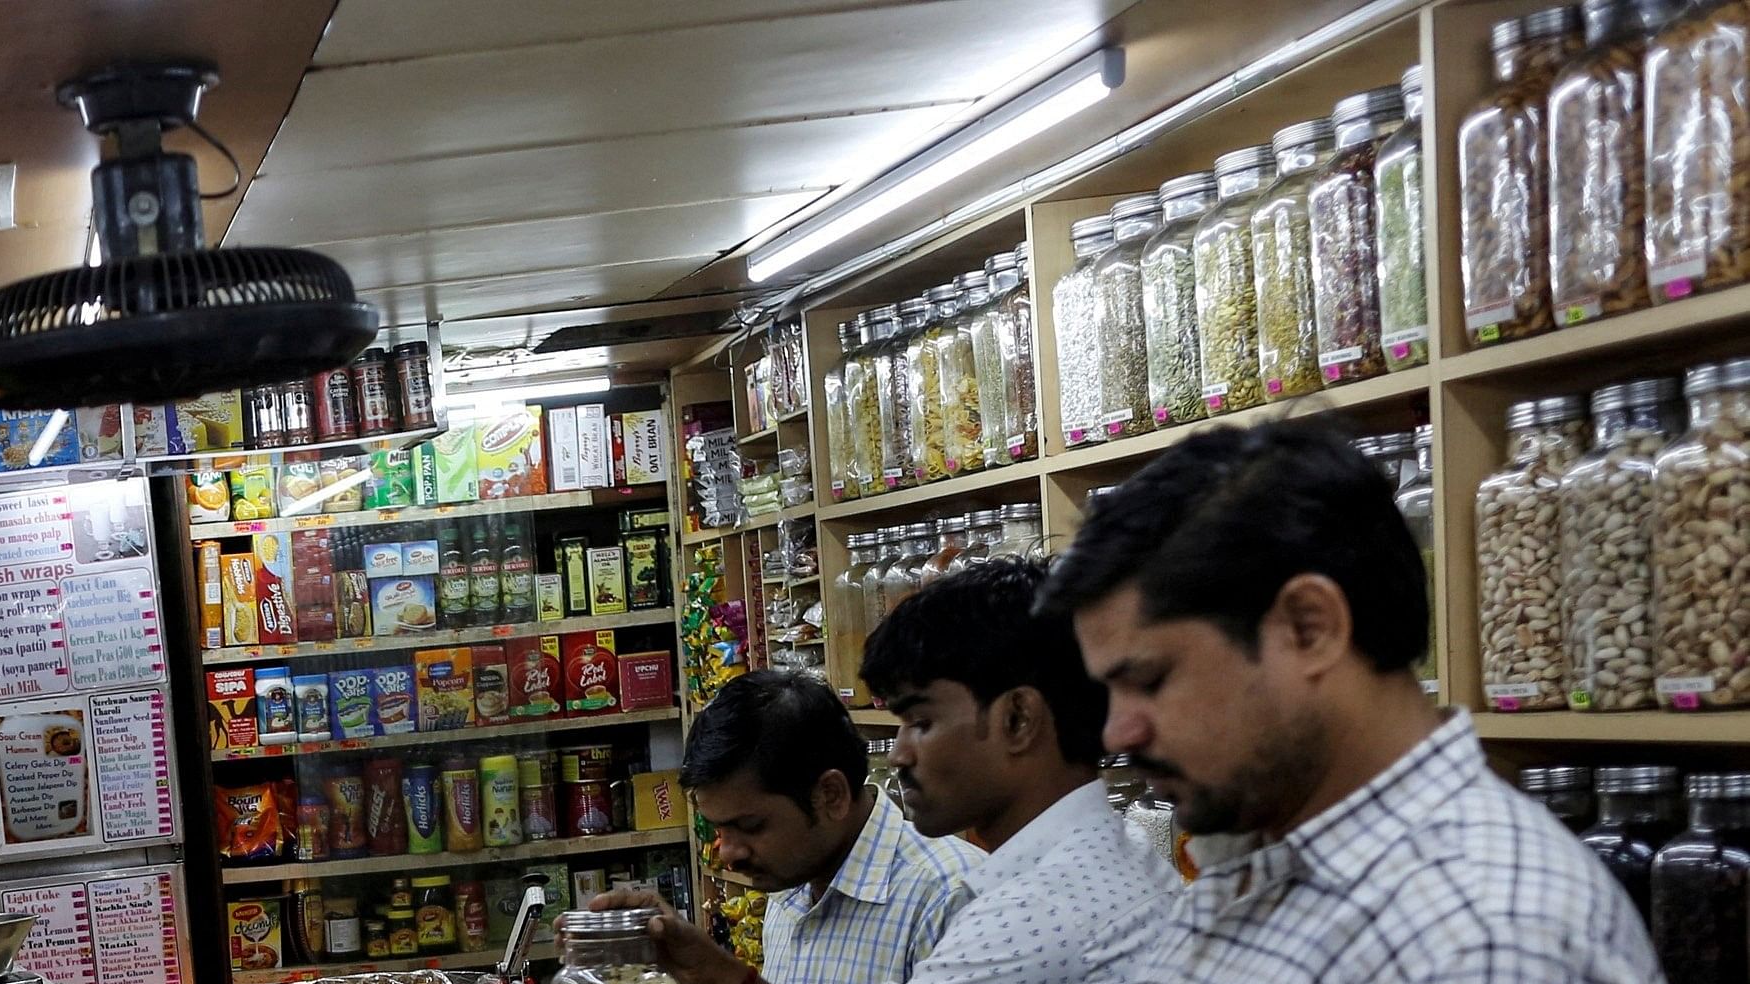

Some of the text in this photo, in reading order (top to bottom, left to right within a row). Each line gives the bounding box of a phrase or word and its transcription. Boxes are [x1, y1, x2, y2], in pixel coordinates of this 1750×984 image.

[590, 422, 599, 444] BRAN
[646, 419, 659, 473] OAT BRAN
[423, 454, 435, 505] POP-PAN
[28, 498, 49, 508] lassi
[0, 515, 31, 528] masala
[8, 531, 38, 544] mango
[41, 528, 62, 540] palp
[20, 562, 74, 581] wraps
[11, 589, 41, 602] wraps
[268, 583, 293, 635] Digestive
[17, 622, 47, 635] wraps
[16, 639, 47, 656] (patti)
[2, 662, 25, 678] (soya
[28, 657, 62, 674] paneer)
[581, 662, 604, 676] Red
[525, 668, 549, 681] Red
[580, 673, 607, 687] Label
[17, 679, 42, 694] Milk
[214, 682, 246, 693] SIPA
[524, 678, 551, 693] Label
[94, 707, 121, 716] Charoli
[19, 732, 42, 740] Cream
[5, 759, 66, 771] Celery Garlic Dip
[6, 769, 74, 782] Cracked Pepper Dip
[228, 795, 262, 806] Bourn
[462, 783, 471, 824] Horlicks
[653, 779, 671, 821] Twix
[419, 786, 428, 829] Horlicks
[6, 890, 61, 904] Light Coke
[94, 889, 113, 897] Toor
[31, 904, 56, 914] Coke
[44, 926, 74, 936] Lemon
[100, 940, 137, 950] Mataki
[45, 971, 75, 981] Water
